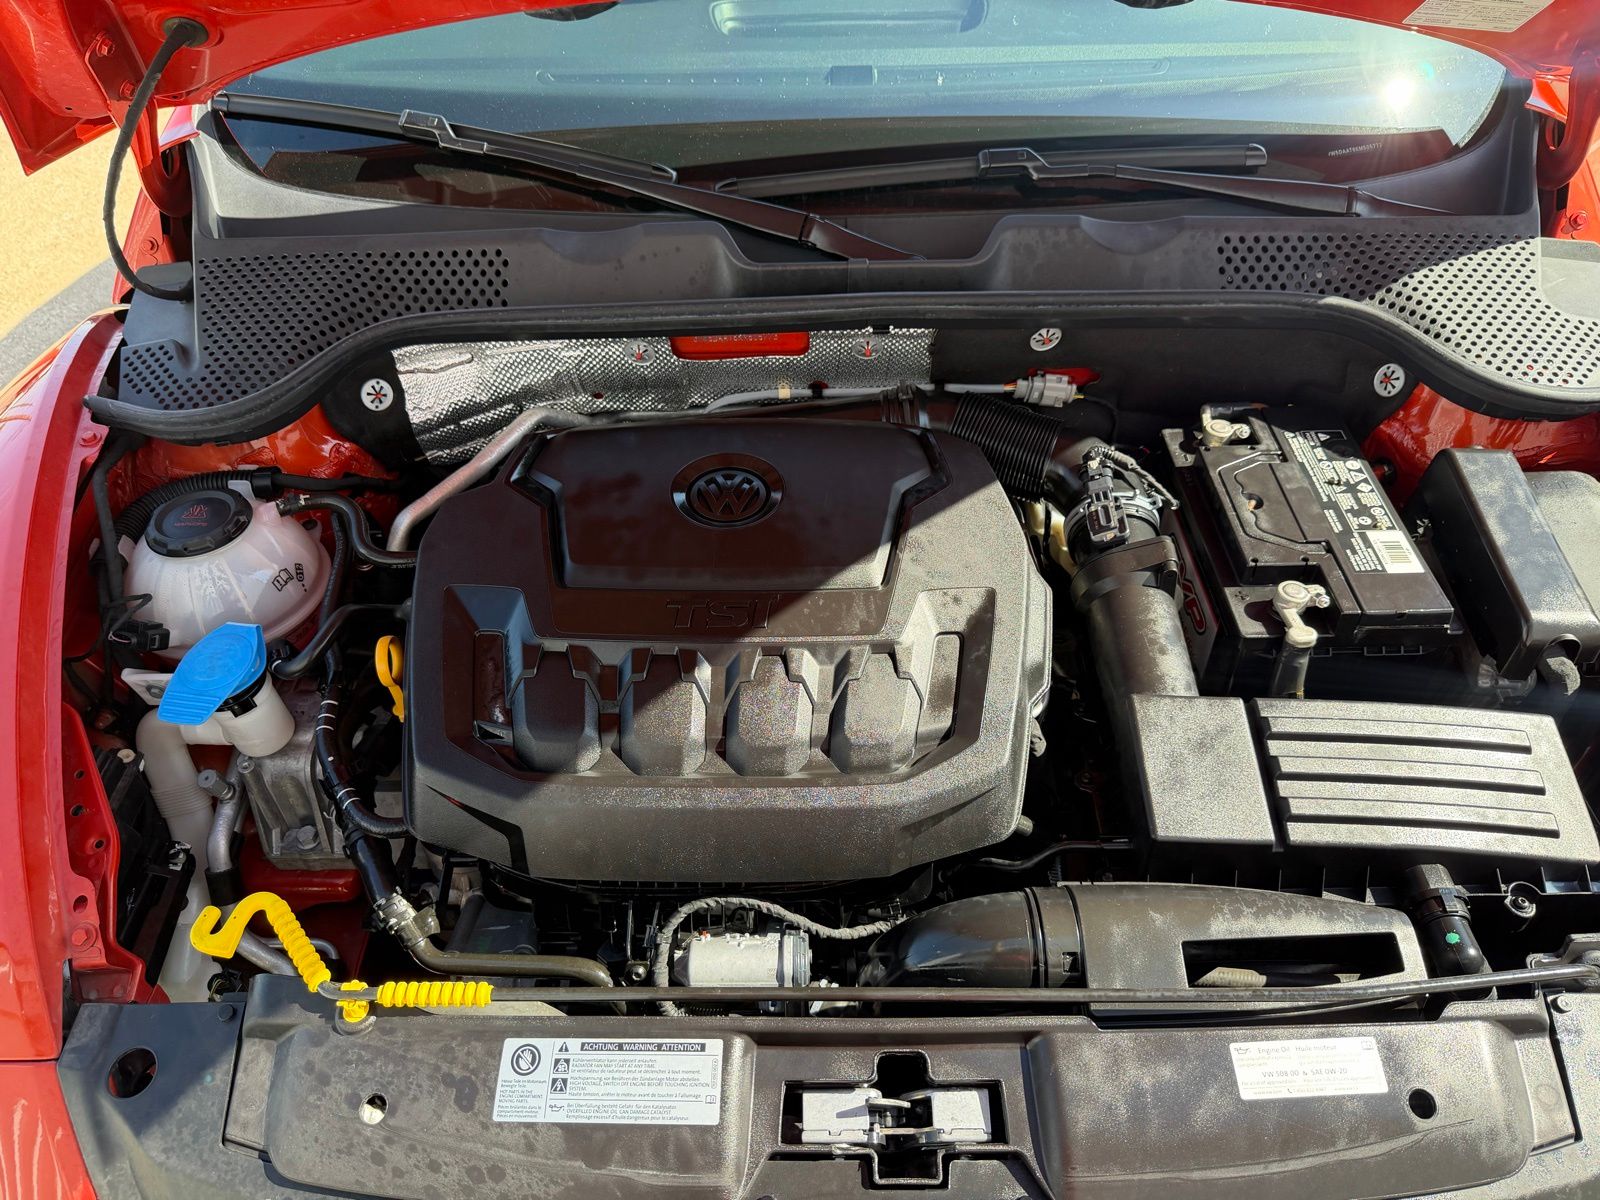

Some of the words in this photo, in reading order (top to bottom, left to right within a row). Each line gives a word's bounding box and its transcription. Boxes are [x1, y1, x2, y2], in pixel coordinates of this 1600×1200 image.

[666, 596, 776, 630] TSI
[584, 1044, 618, 1052] ACHTUNG
[622, 1044, 658, 1052] WARNING
[662, 1044, 702, 1052] ATTENTION
